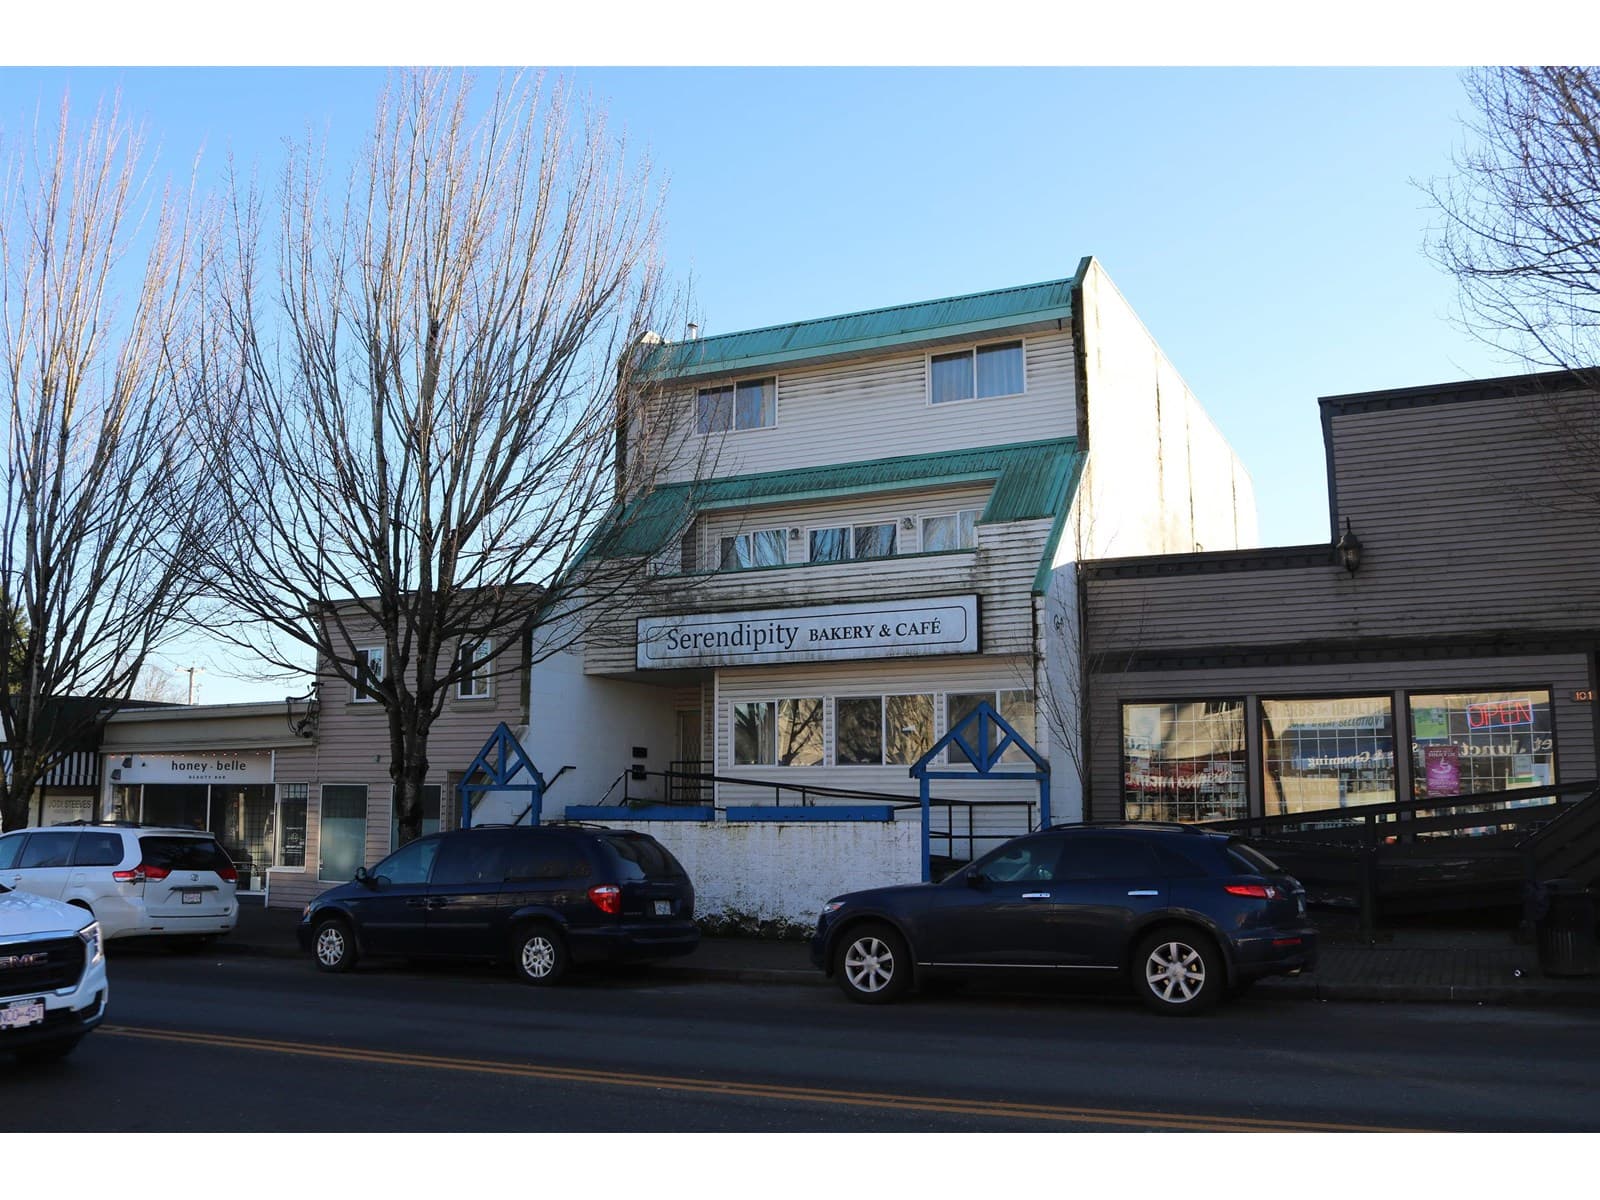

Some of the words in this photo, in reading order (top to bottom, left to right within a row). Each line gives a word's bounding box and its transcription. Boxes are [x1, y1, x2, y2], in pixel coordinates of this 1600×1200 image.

[667, 622, 800, 650] Serendipity
[809, 625, 875, 642] BAKERY
[879, 623, 892, 637] &
[895, 617, 942, 637] CAFÉ
[1576, 690, 1593, 701] 101
[1468, 700, 1532, 727] OPEN
[171, 760, 208, 772] honey
[216, 760, 247, 771] belle
